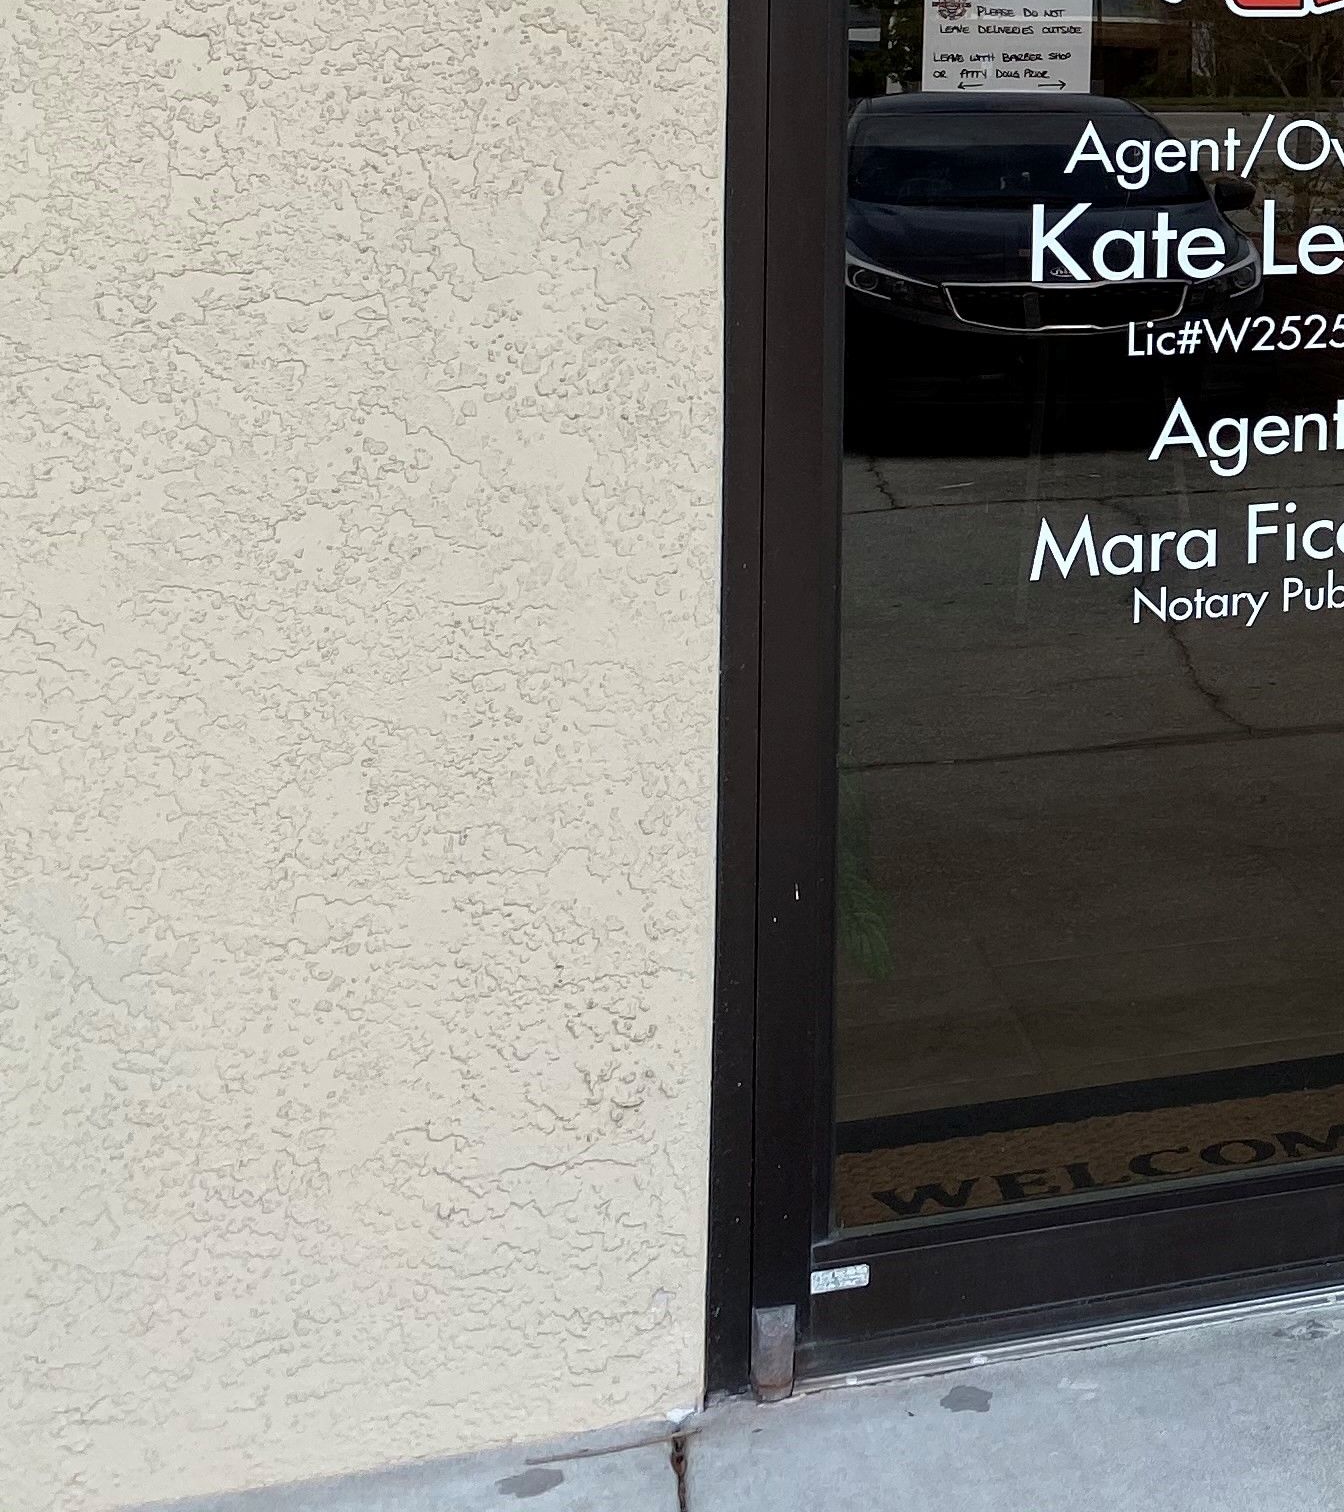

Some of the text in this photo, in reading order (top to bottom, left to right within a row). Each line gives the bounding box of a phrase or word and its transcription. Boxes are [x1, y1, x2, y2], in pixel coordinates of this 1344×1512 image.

[1043, 8, 1066, 18] NOT
[1031, 201, 1226, 285] Kate
[1029, 515, 1217, 582] Mara
[1133, 586, 1269, 627] Notary
